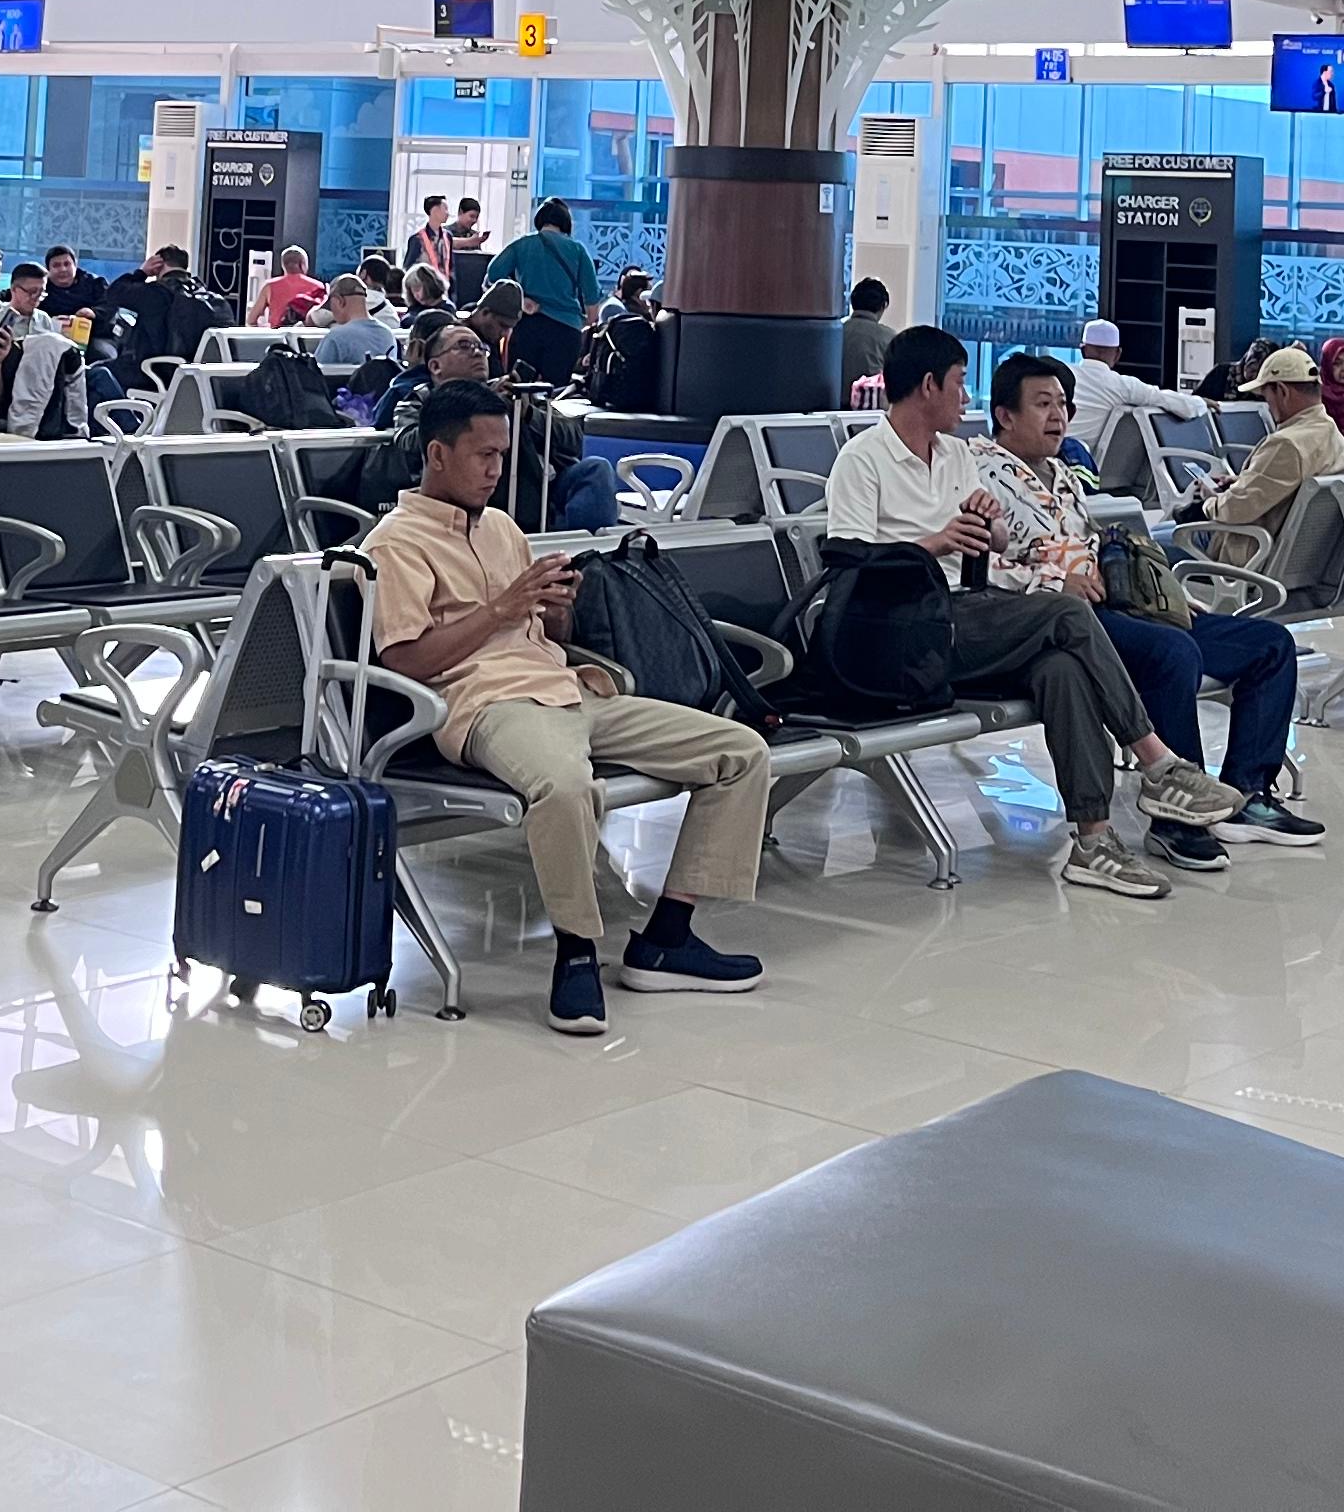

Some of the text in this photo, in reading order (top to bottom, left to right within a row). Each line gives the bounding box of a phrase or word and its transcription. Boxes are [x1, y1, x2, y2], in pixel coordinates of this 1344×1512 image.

[440, 4, 447, 18] 3
[524, 24, 537, 47] 3
[226, 130, 244, 142] FOR
[243, 131, 288, 143] CUSTOMER
[212, 161, 254, 173] CHARGER
[1103, 155, 1234, 171] FREE FOR CUSTOMER
[212, 174, 253, 186] STATION
[1117, 195, 1180, 209] CHARGER
[1116, 211, 1179, 226] STATION
